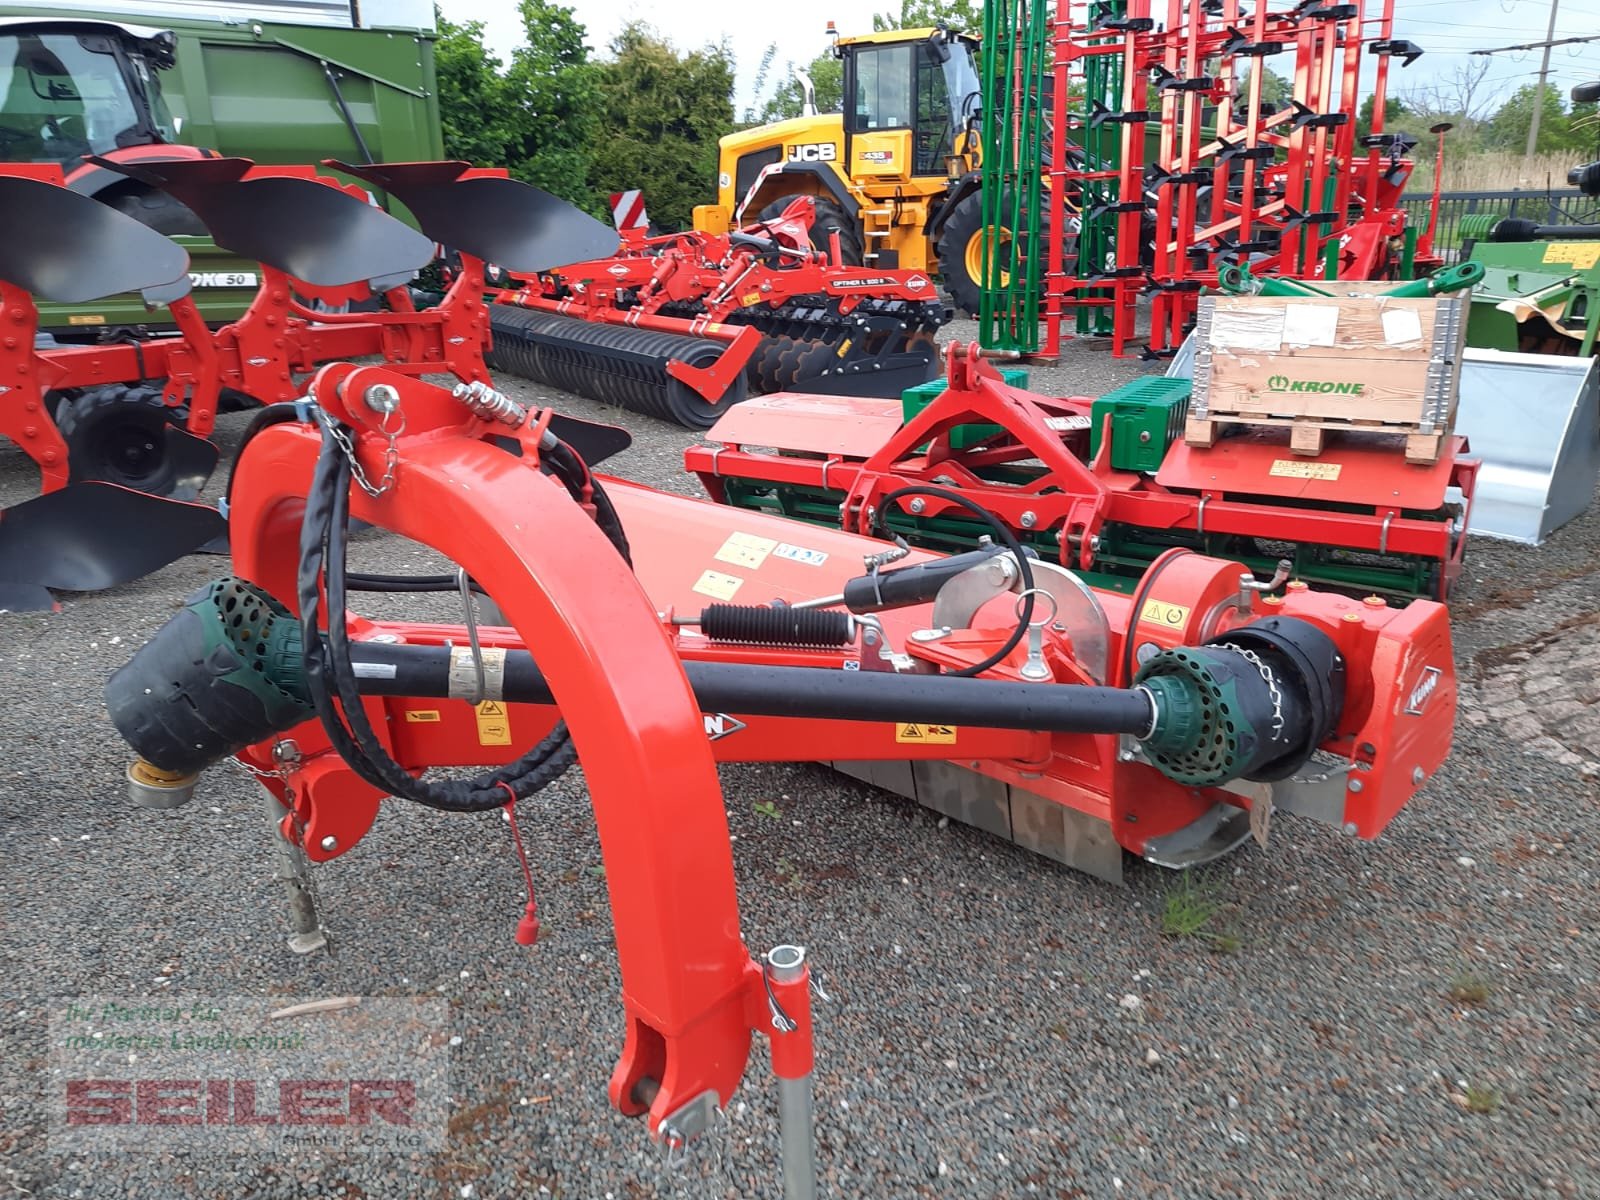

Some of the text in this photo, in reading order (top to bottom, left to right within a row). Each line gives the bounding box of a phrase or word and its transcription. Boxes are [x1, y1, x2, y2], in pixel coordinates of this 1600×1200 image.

[788, 143, 836, 162] JCB
[226, 274, 245, 285] 50
[1289, 380, 1366, 395] KRONE
